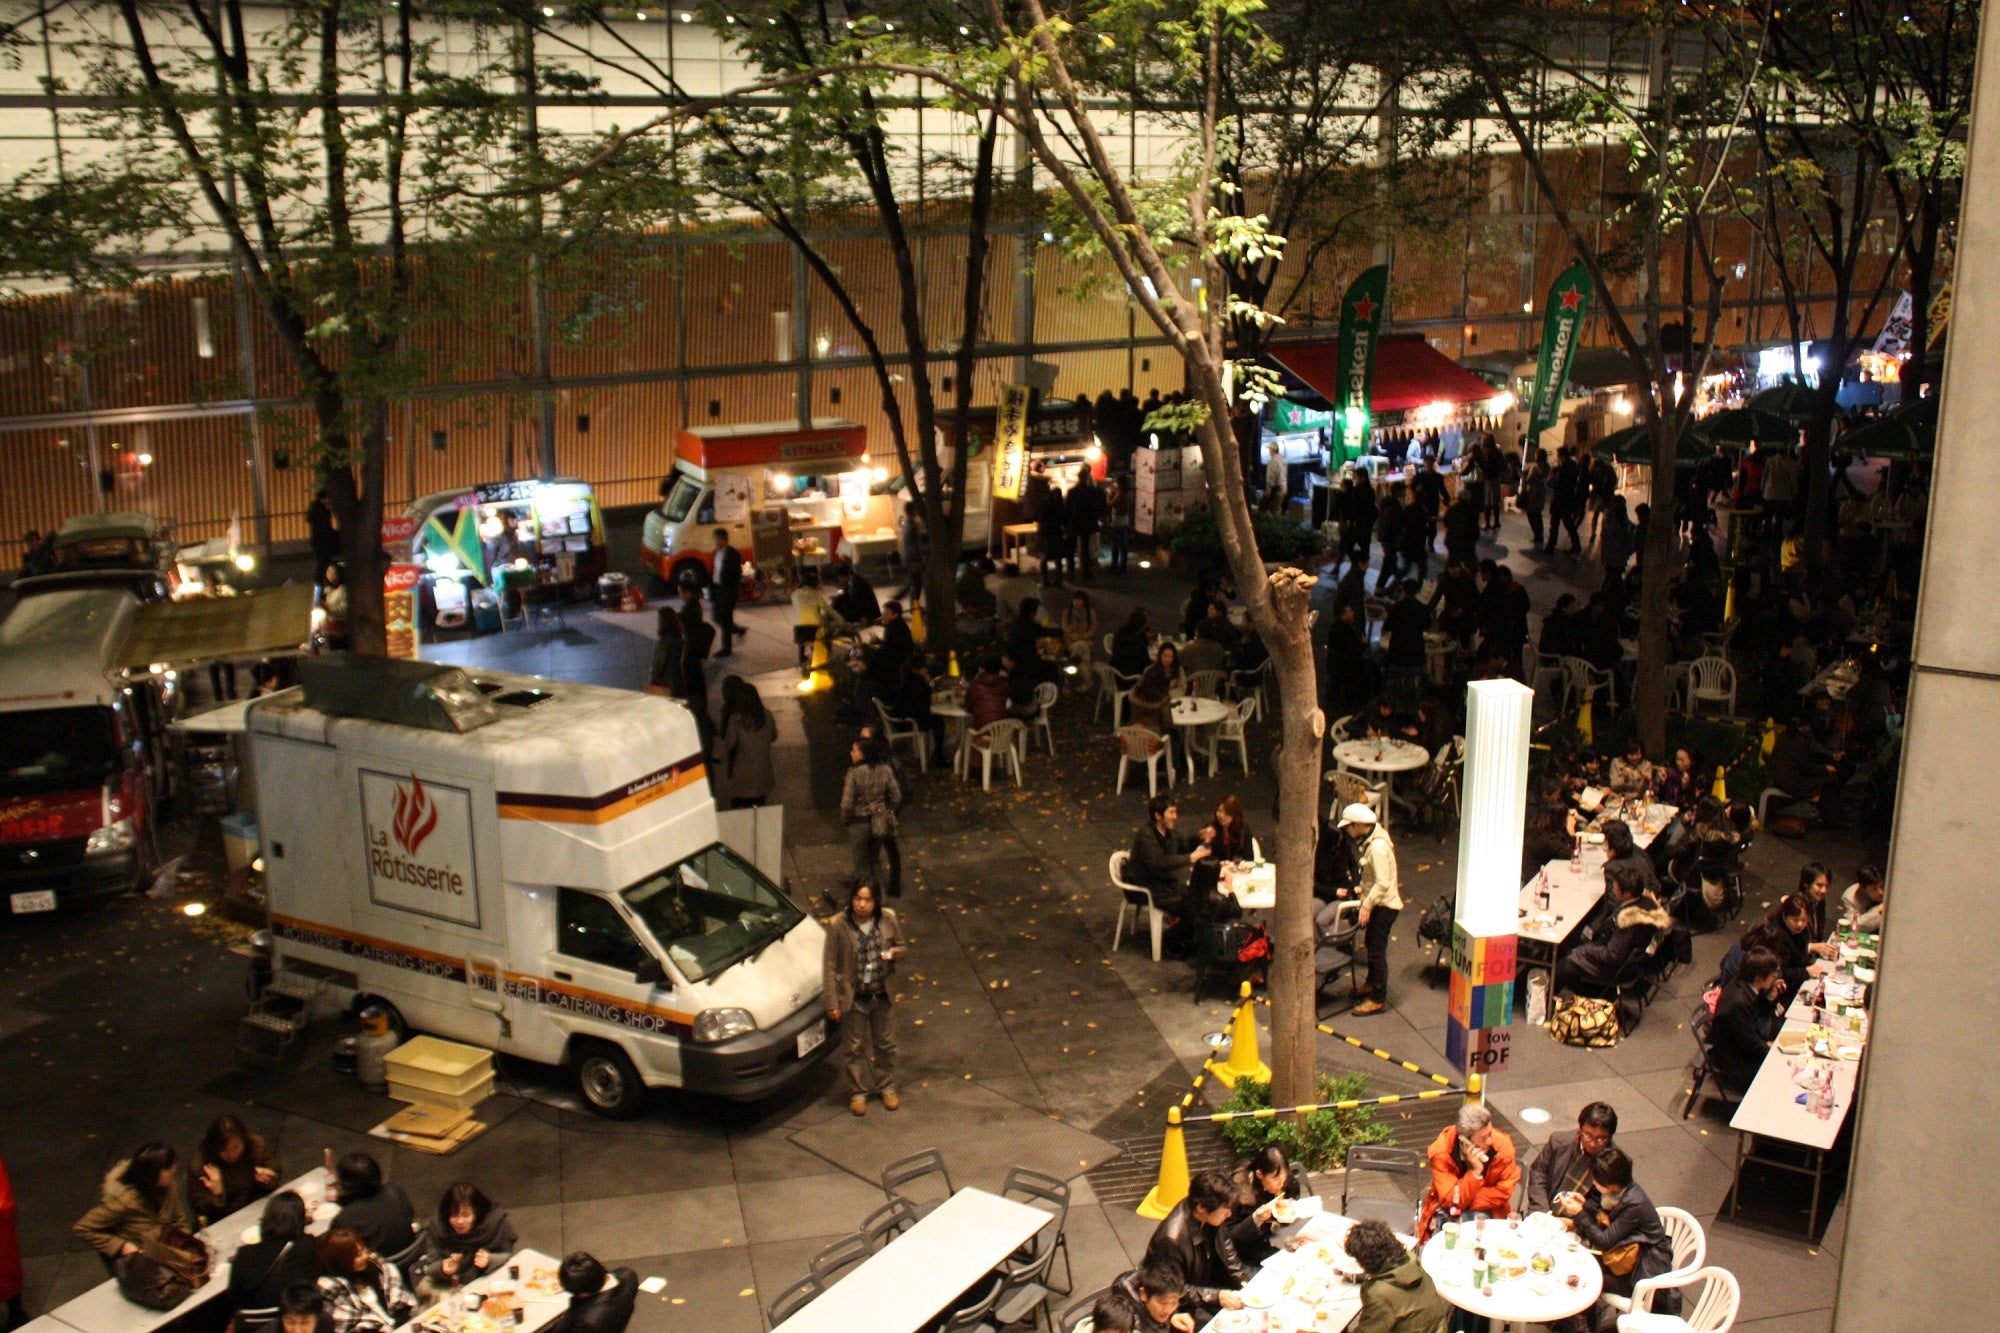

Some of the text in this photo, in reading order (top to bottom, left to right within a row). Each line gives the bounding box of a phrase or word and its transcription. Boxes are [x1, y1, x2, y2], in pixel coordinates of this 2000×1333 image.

[1344, 329, 1369, 447] Hneken
[1538, 317, 1574, 421] Heineken
[369, 823, 387, 847] La
[371, 848, 464, 896] Rôtisserie
[351, 941, 415, 971] CATERING
[419, 958, 453, 979] SHOP
[1453, 948, 1472, 977] UM
[545, 991, 620, 1022] CATERING
[624, 1010, 665, 1033] SHOP
